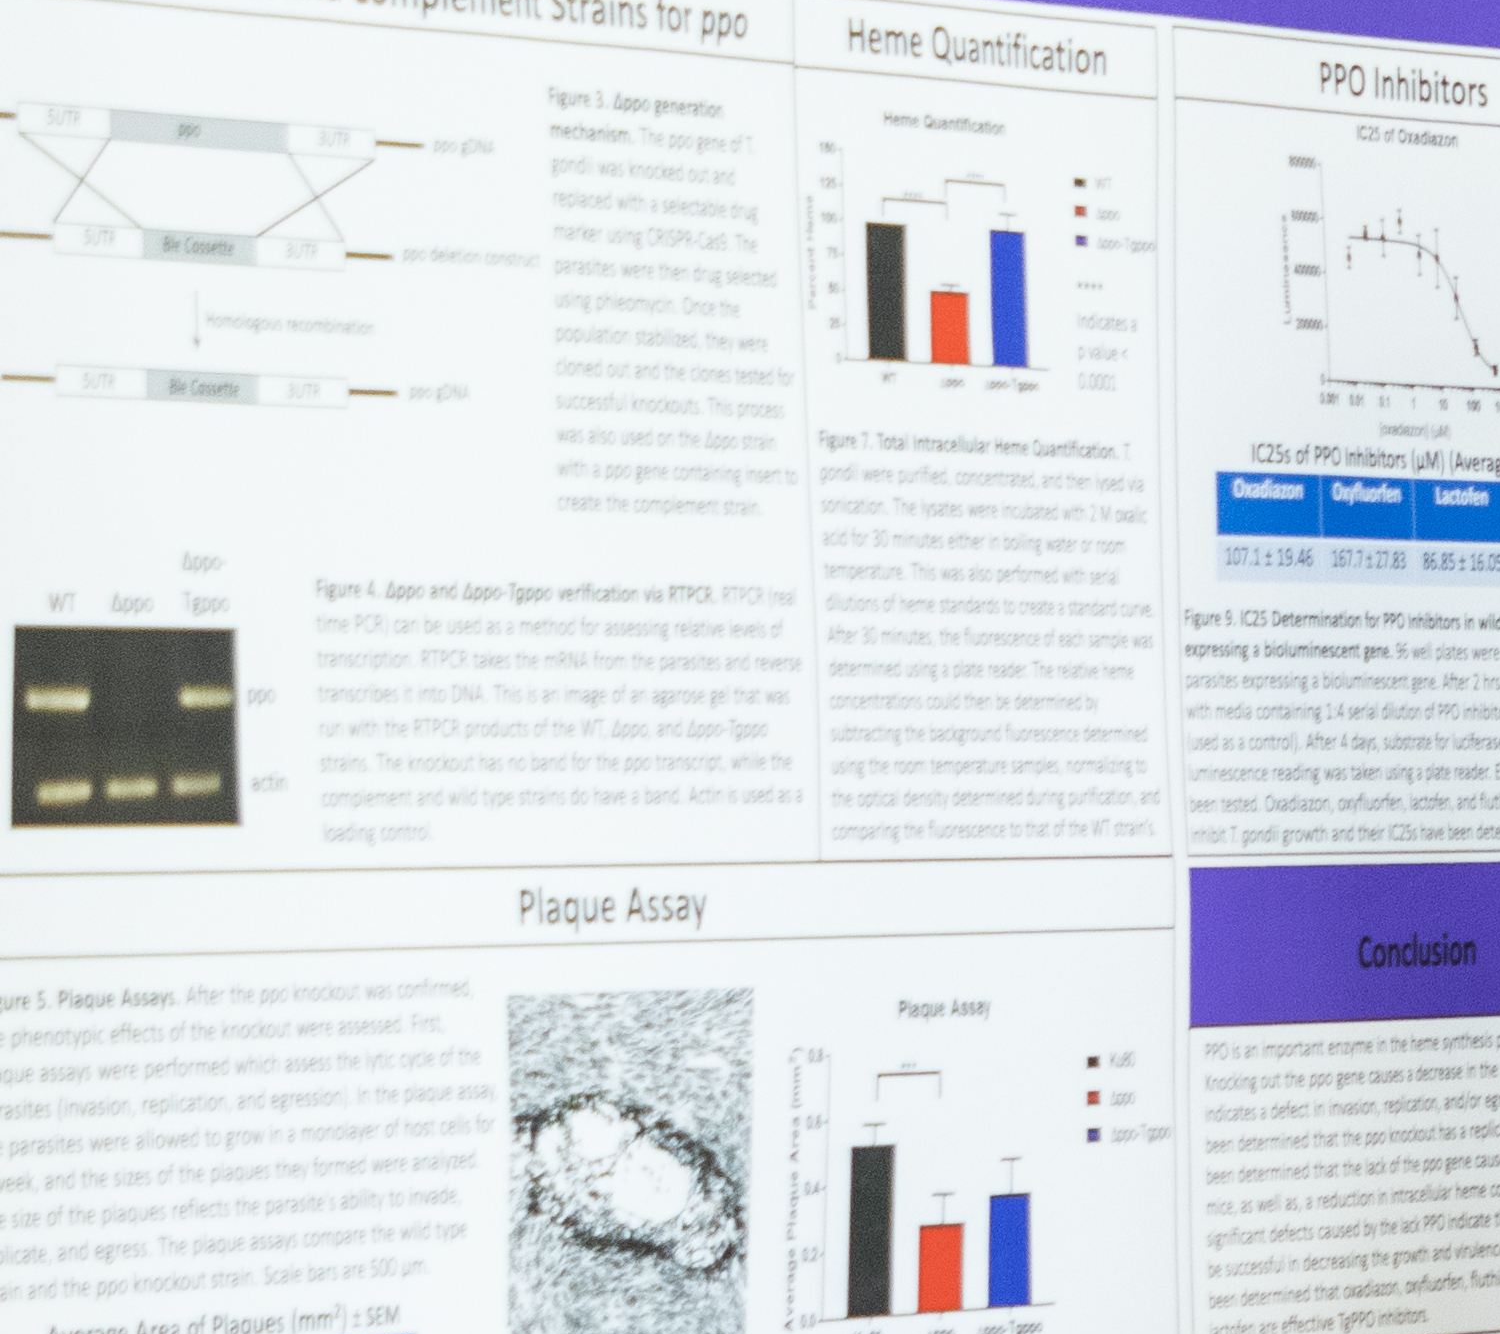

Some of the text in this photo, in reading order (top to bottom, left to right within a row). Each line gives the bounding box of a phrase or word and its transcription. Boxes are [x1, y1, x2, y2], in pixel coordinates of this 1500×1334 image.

[700, 9, 748, 43] ppo
[847, 19, 1107, 76] Heme Quantification
[1318, 60, 1489, 109] PPO Inhibitors
[882, 112, 1006, 136] Heme Quantification
[1355, 123, 1459, 148] IC25 of Oxadiazon
[1250, 441, 1293, 466] IC25s
[1294, 443, 1311, 466] of
[1313, 444, 1342, 467] PPO
[1344, 448, 1408, 470] Inhibitors
[1231, 476, 1305, 500] Oxadiazon
[1434, 485, 1490, 507] Lactofen
[518, 886, 707, 932] Plaque Assay
[1357, 932, 1478, 970] Conclusion
[897, 998, 991, 1021] Plaque Assay
[365, 1304, 401, 1328] SEM
